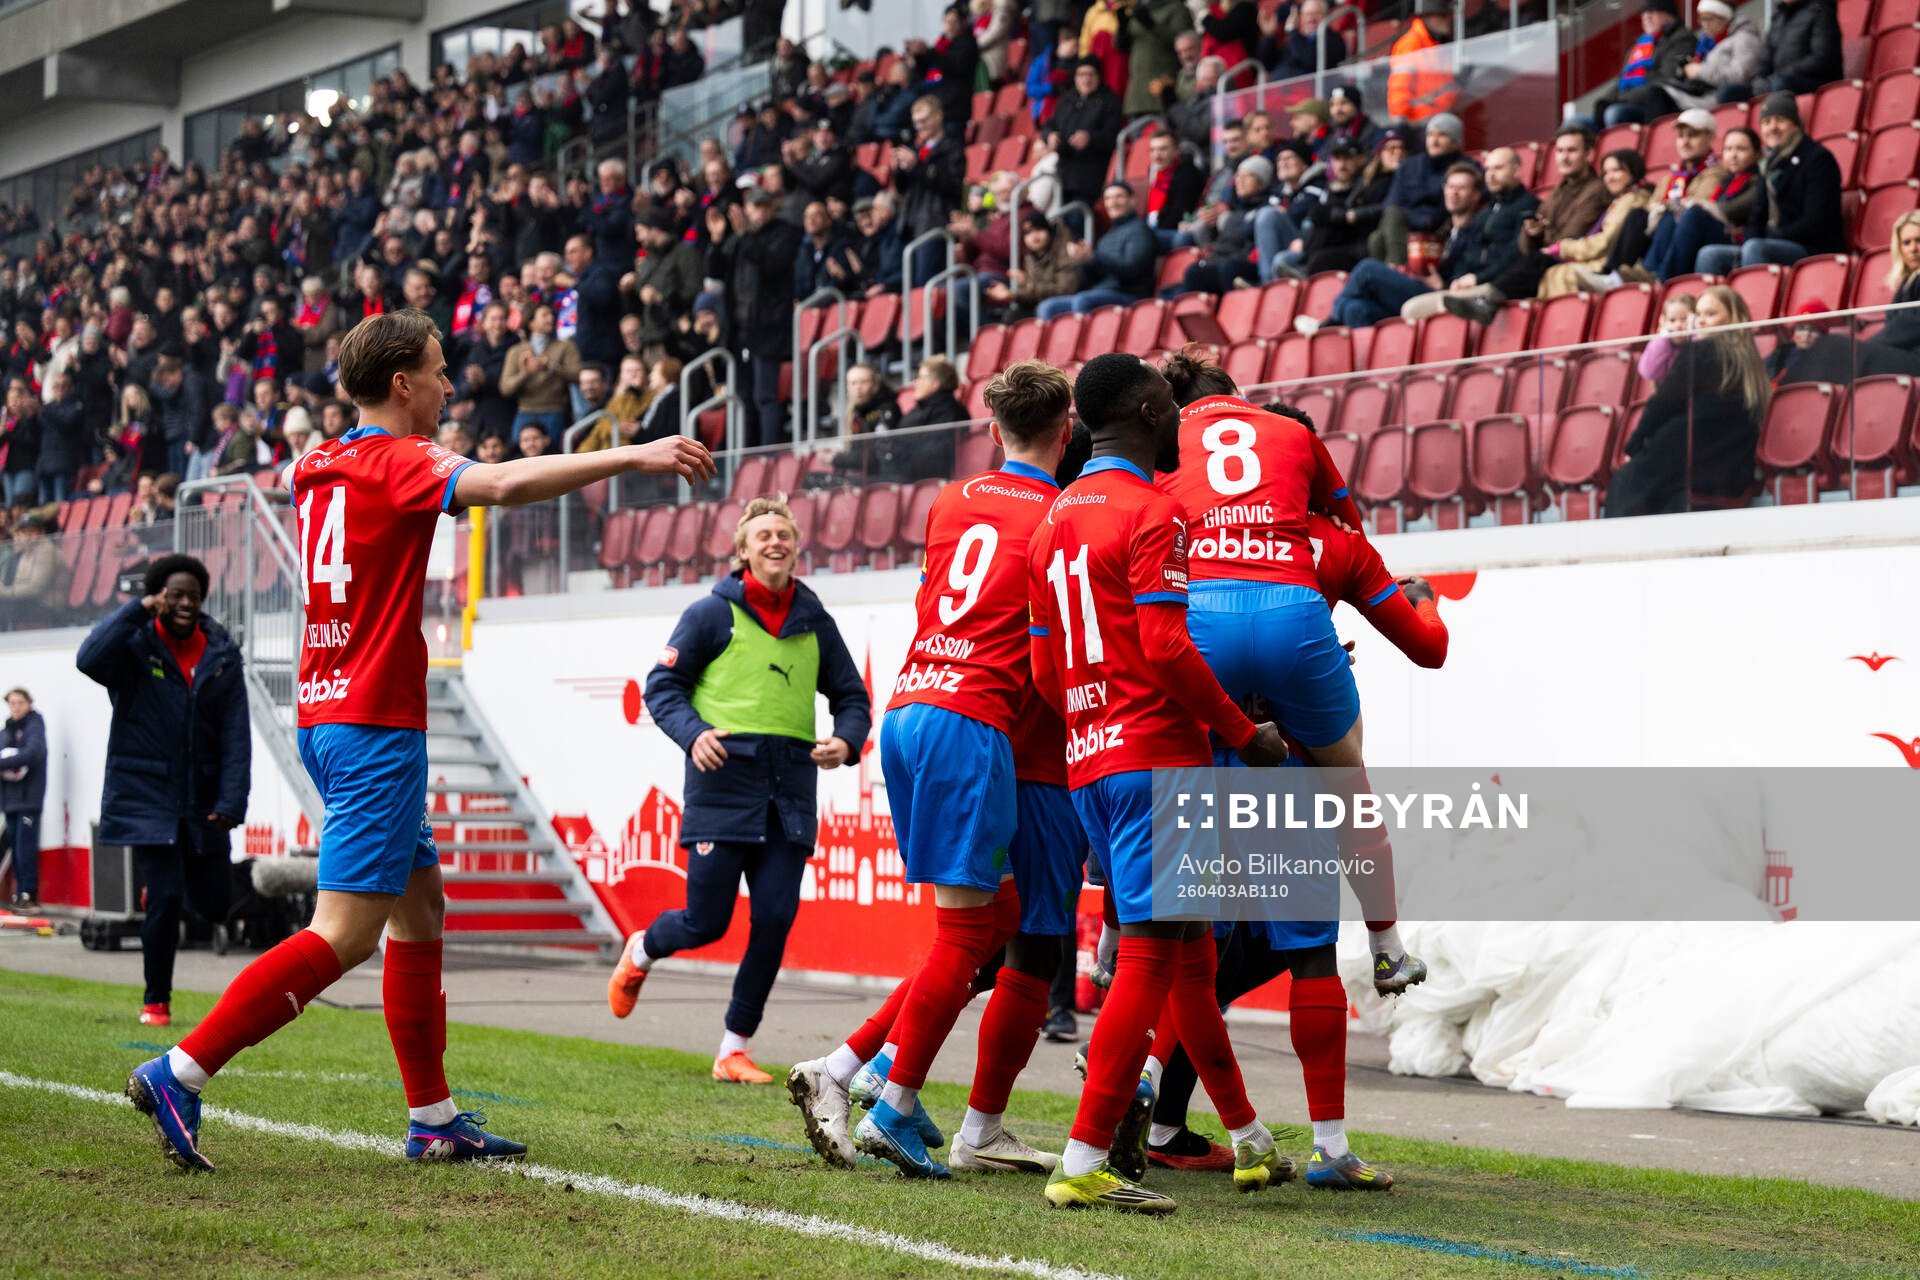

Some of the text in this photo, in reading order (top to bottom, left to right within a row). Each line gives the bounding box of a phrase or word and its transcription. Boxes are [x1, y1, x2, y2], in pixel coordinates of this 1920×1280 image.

[1202, 418, 1261, 496] 8
[976, 483, 1044, 503] NPSolution
[1202, 500, 1274, 529] GIGOVIĆ
[300, 486, 352, 606] 14
[938, 523, 999, 626] 9
[1047, 544, 1104, 669] 11
[298, 669, 351, 705] obbiz
[896, 662, 965, 695] obbiz
[1066, 723, 1124, 765] obbiz
